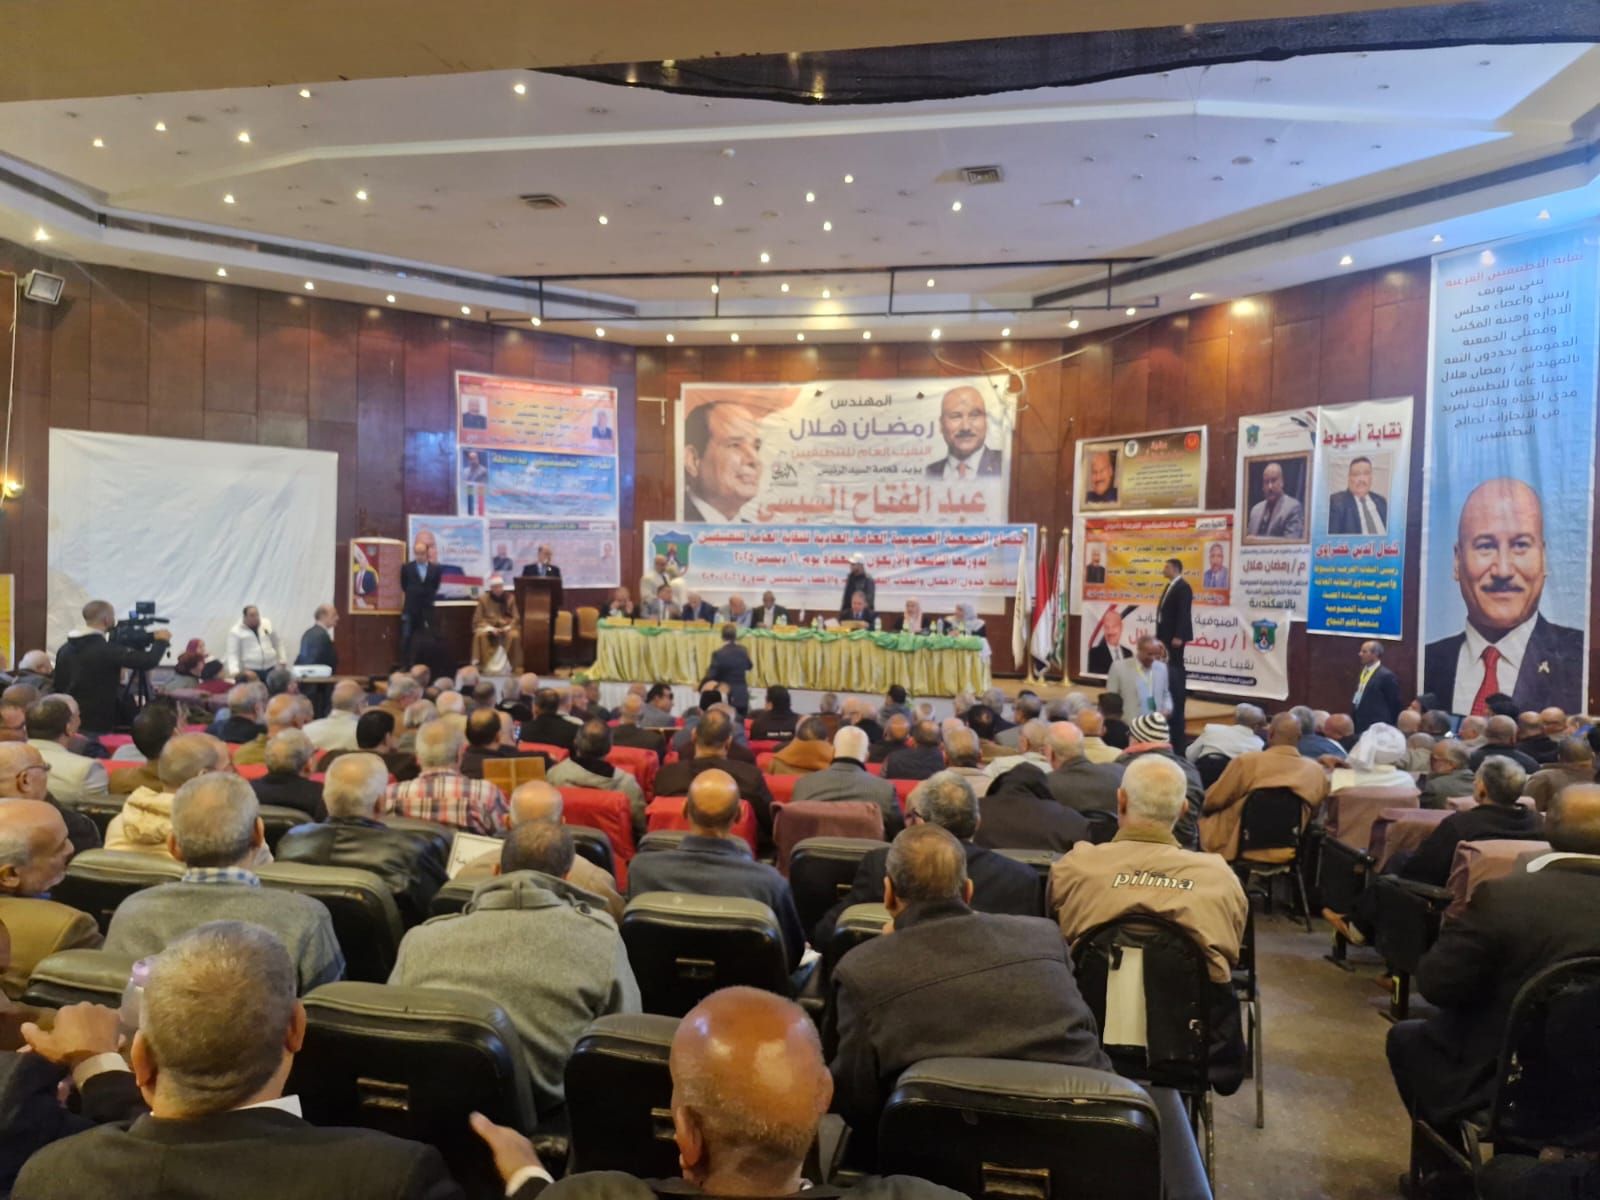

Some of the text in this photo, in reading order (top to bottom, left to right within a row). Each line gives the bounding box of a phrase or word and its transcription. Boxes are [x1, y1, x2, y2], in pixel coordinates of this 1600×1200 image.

[831, 394, 892, 409] المهندس
[789, 417, 934, 440] رمضان هلال
[1367, 422, 1402, 448] نقابة
[852, 482, 931, 523] الفتاح
[938, 487, 986, 523] عبد
[1185, 632, 1226, 652] رمض
